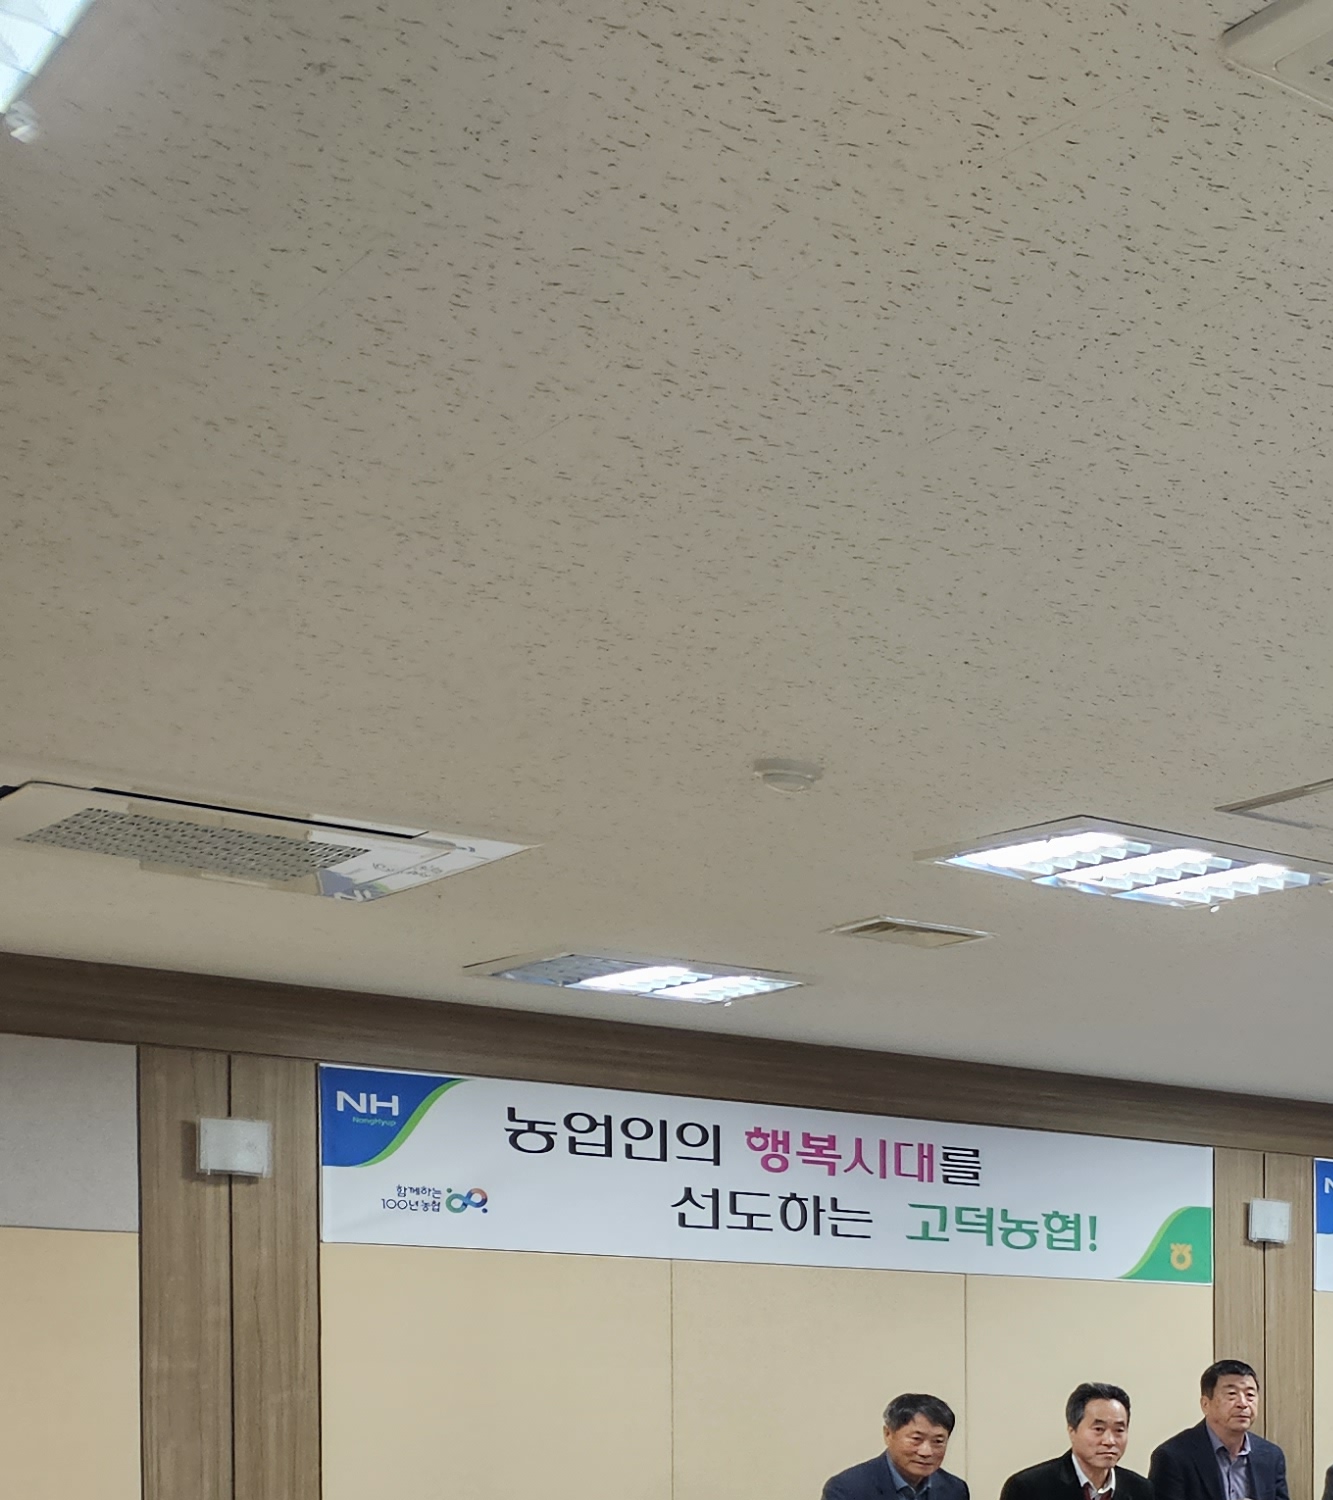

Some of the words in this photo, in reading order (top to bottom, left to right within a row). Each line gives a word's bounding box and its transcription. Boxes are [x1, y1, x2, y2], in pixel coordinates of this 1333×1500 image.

[336, 1090, 399, 1116] NH
[504, 1106, 721, 1166] 농업인의
[745, 1126, 982, 1187] 행복시대를
[396, 1184, 442, 1199] 함께하는
[381, 1199, 419, 1212] 100년
[421, 1200, 441, 1213] 농협
[670, 1187, 873, 1239] 선도하는
[905, 1203, 1098, 1253] 고덕농협!
